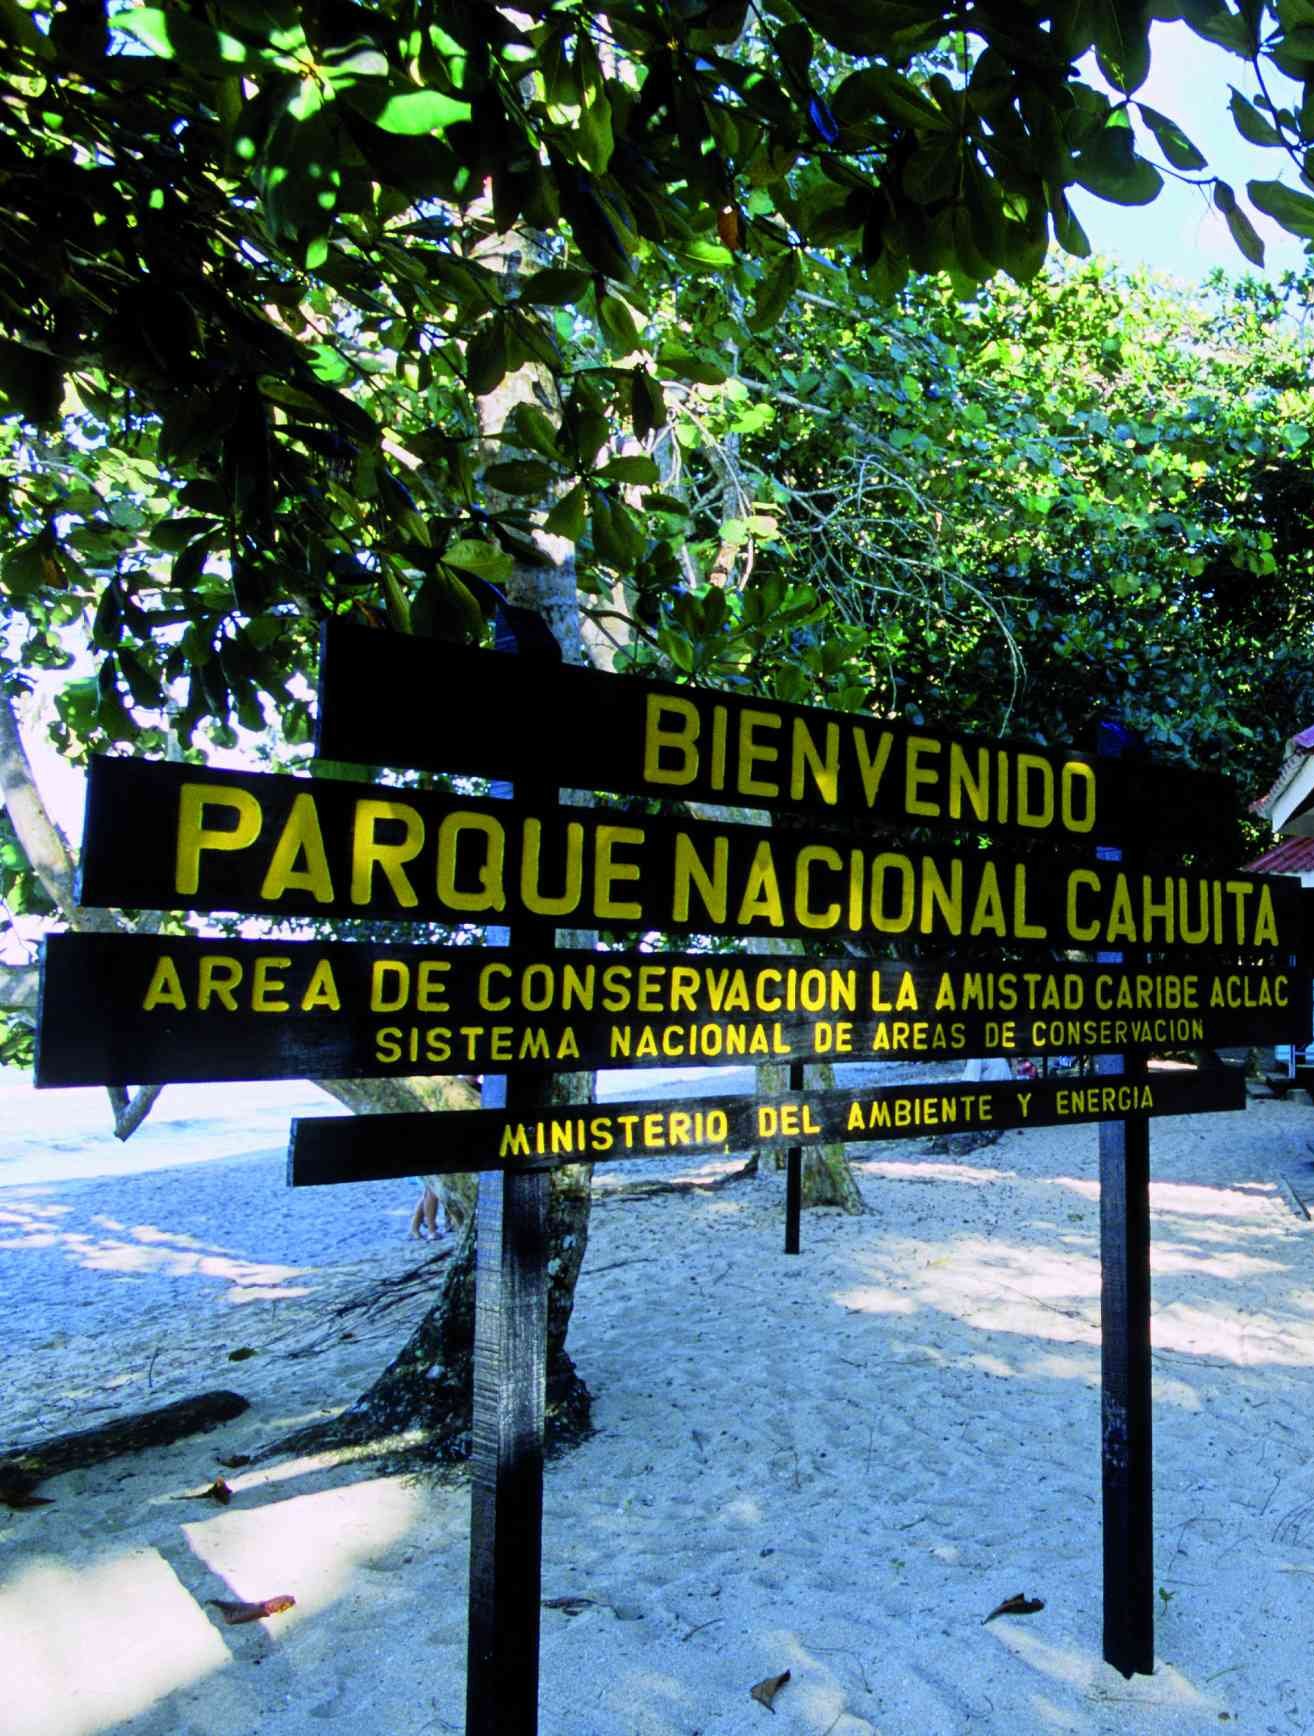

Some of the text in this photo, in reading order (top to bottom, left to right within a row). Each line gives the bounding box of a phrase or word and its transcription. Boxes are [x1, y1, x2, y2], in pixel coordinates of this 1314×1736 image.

[645, 695, 1096, 832] BIENVENIDO
[176, 784, 1278, 946] PARQUE NACIONAL CAHUITA
[144, 957, 1289, 1013] AREA DE CONSERVACION LA AMISTAD CARIBE ACLAC
[377, 1019, 1204, 1062] SISTEMA NACIONAL DE AREAS DE CONSERVACION
[500, 1086, 1154, 1157] MINISTERIO DEL AMBIENTE Y ENERGIA
